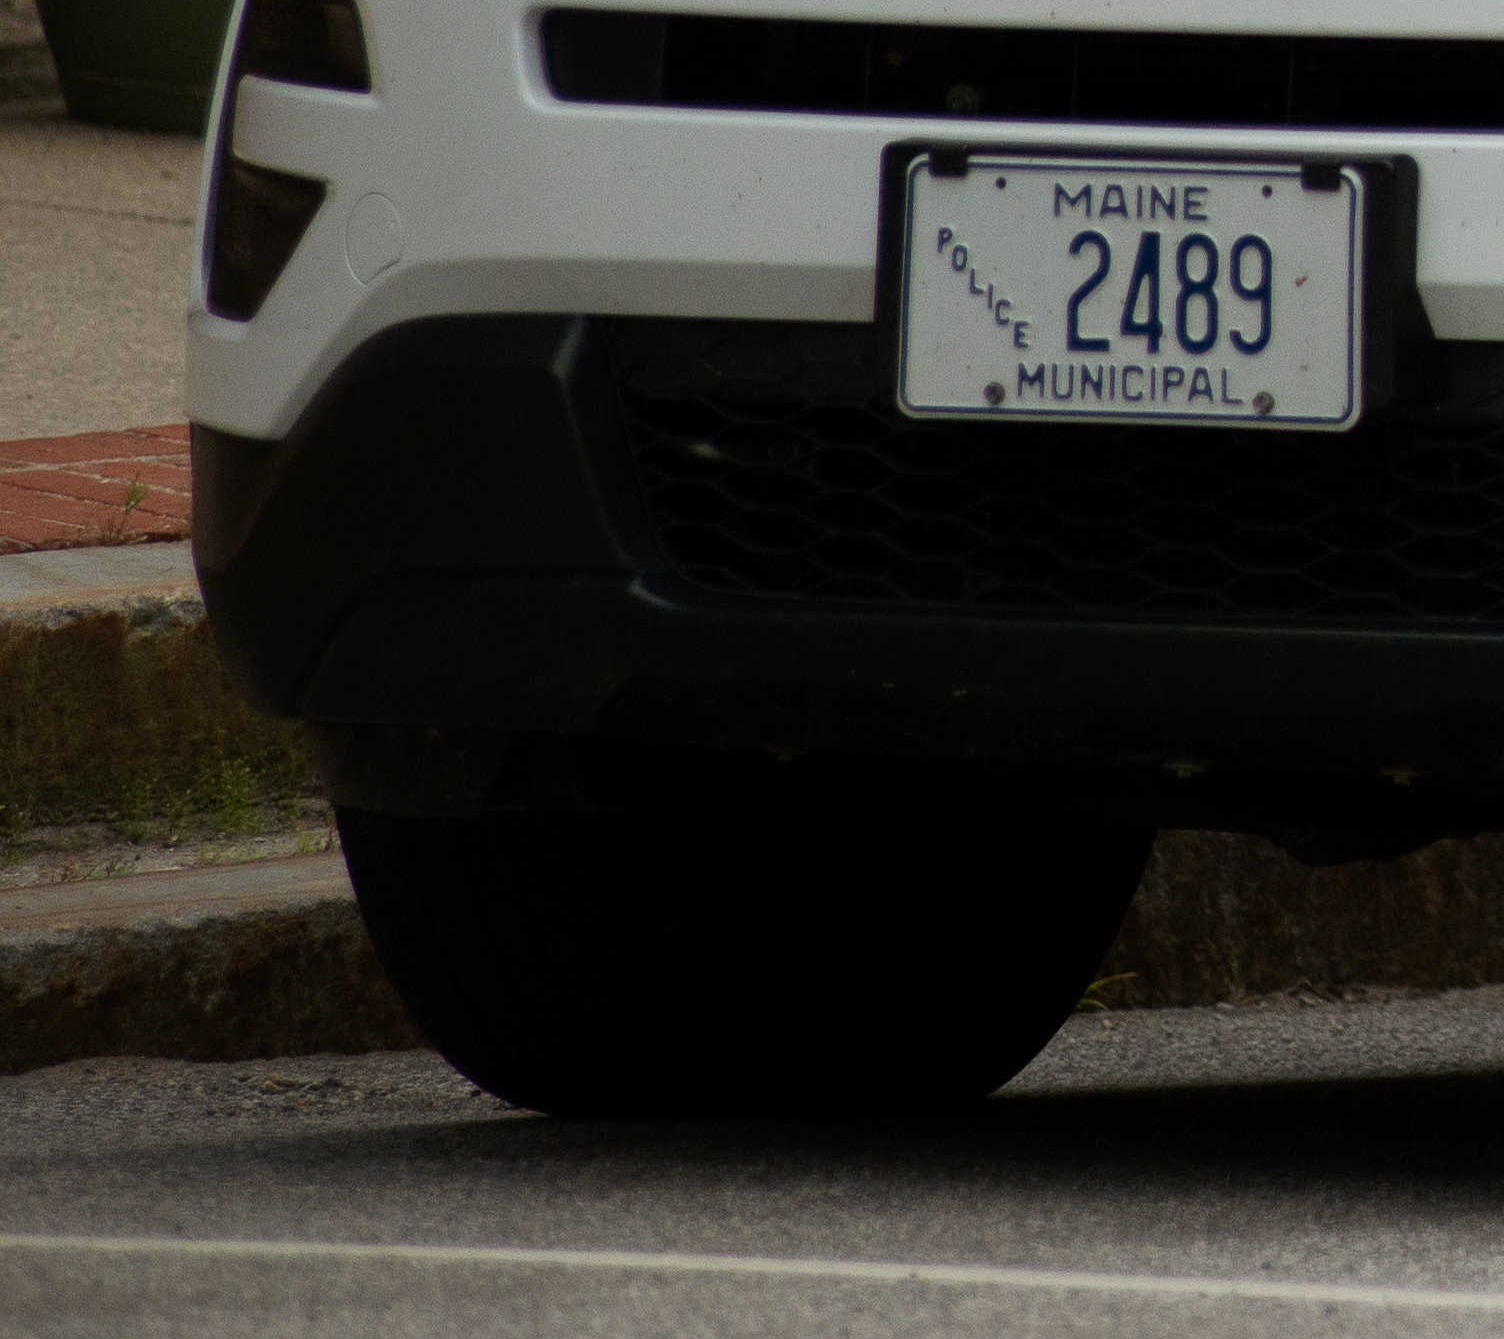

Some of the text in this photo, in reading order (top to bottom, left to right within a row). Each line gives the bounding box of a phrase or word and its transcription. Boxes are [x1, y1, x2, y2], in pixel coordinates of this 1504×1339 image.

[1053, 182, 1210, 222] MAINE
[937, 226, 1031, 349] POLICE
[1066, 229, 1273, 356] 2489
[1016, 362, 1244, 406] MUNICIPAL
